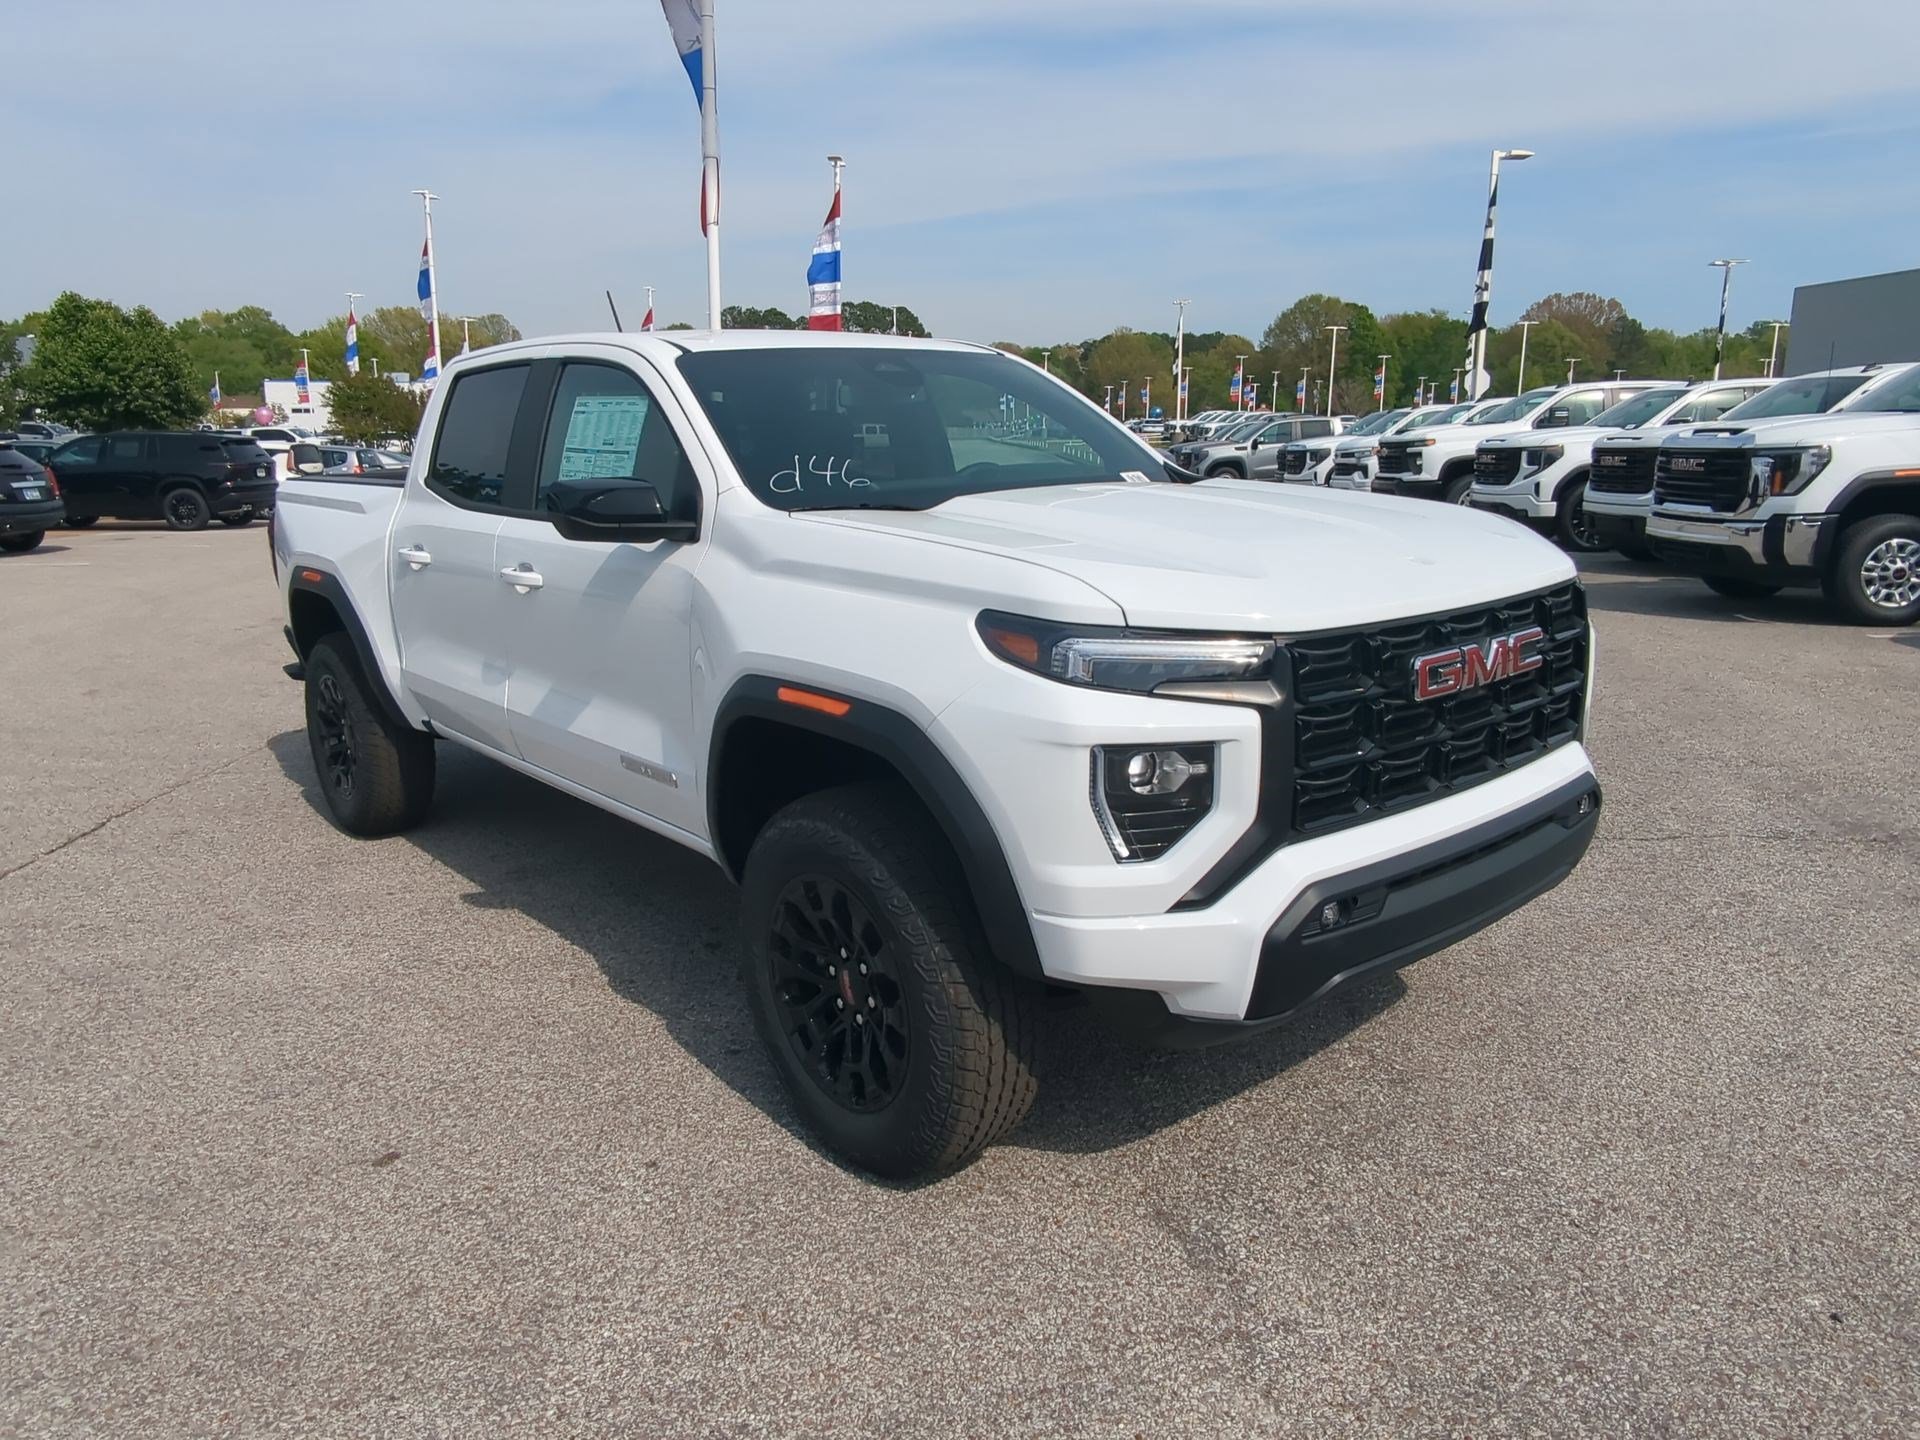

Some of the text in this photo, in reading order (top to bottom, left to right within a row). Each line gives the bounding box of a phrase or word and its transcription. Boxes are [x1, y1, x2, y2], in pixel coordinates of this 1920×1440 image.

[769, 454, 871, 493] d46
[1672, 458, 1706, 472] GMC
[1414, 626, 1544, 701] GMC
